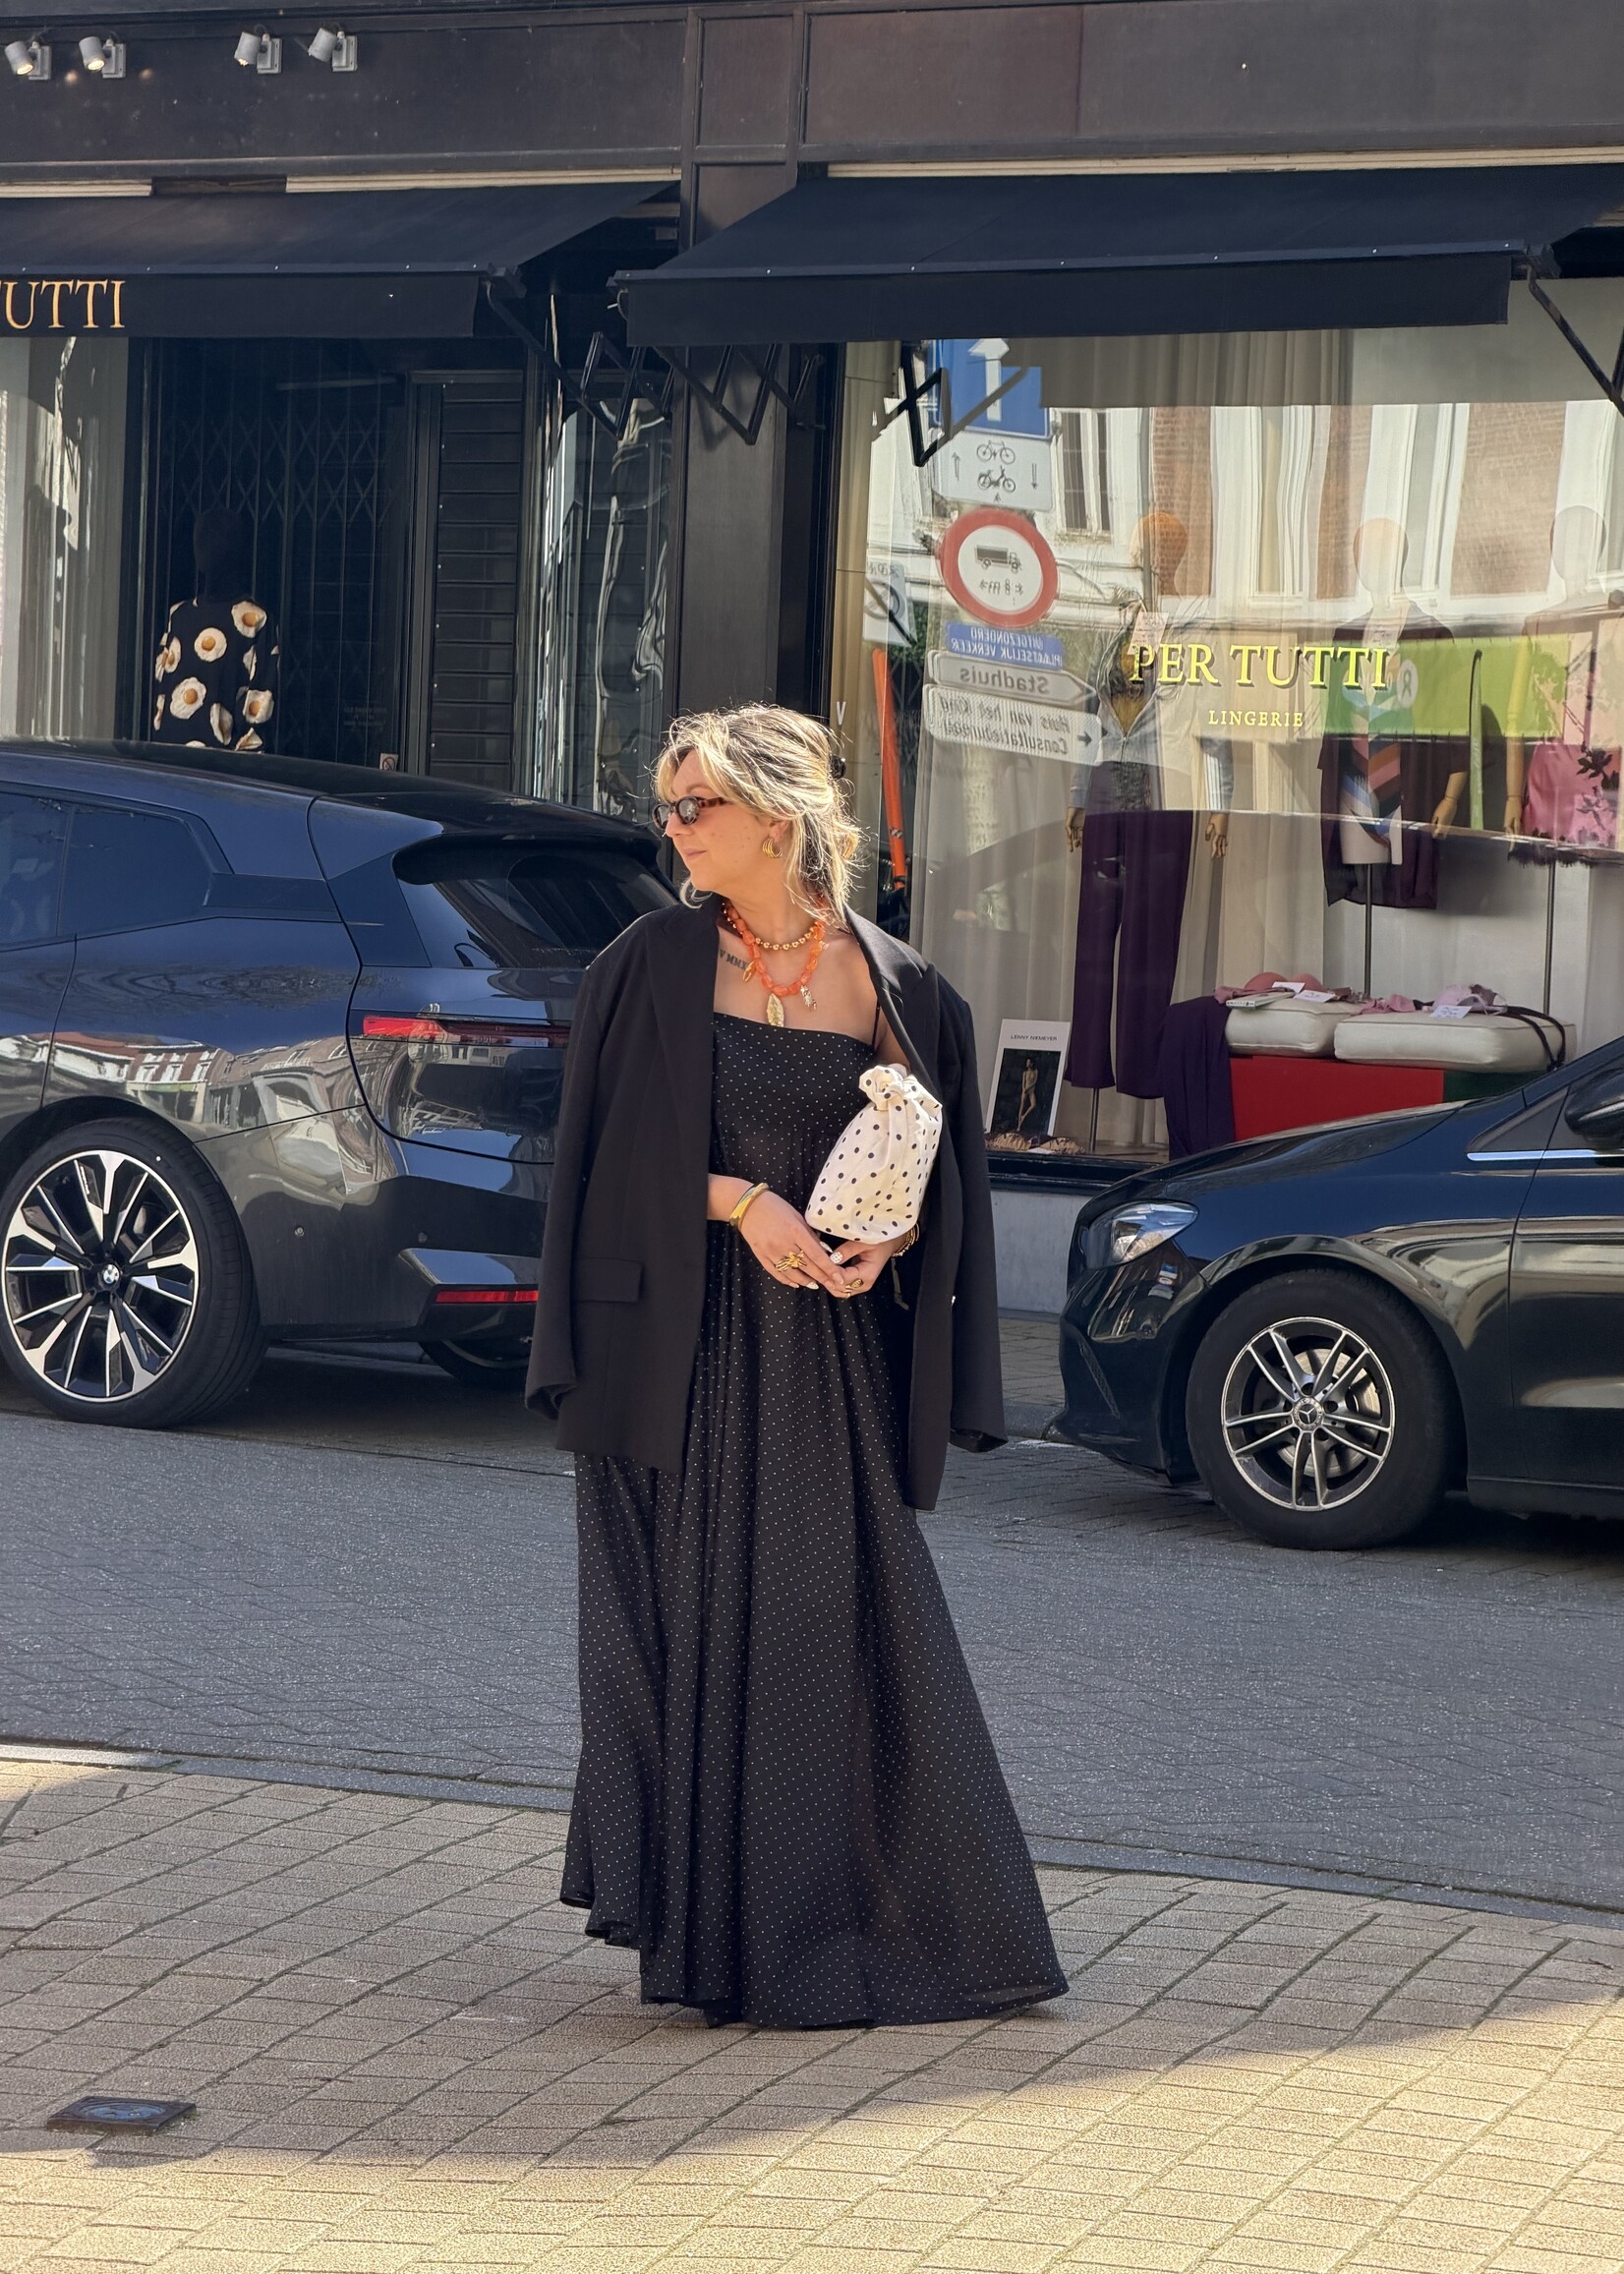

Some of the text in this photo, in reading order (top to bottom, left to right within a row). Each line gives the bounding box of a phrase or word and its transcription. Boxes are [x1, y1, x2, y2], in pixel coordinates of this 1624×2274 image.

[0, 279, 126, 329] UTTI
[1130, 643, 1391, 687] PER TUTTI
[1208, 710, 1304, 728] LINGERIE
